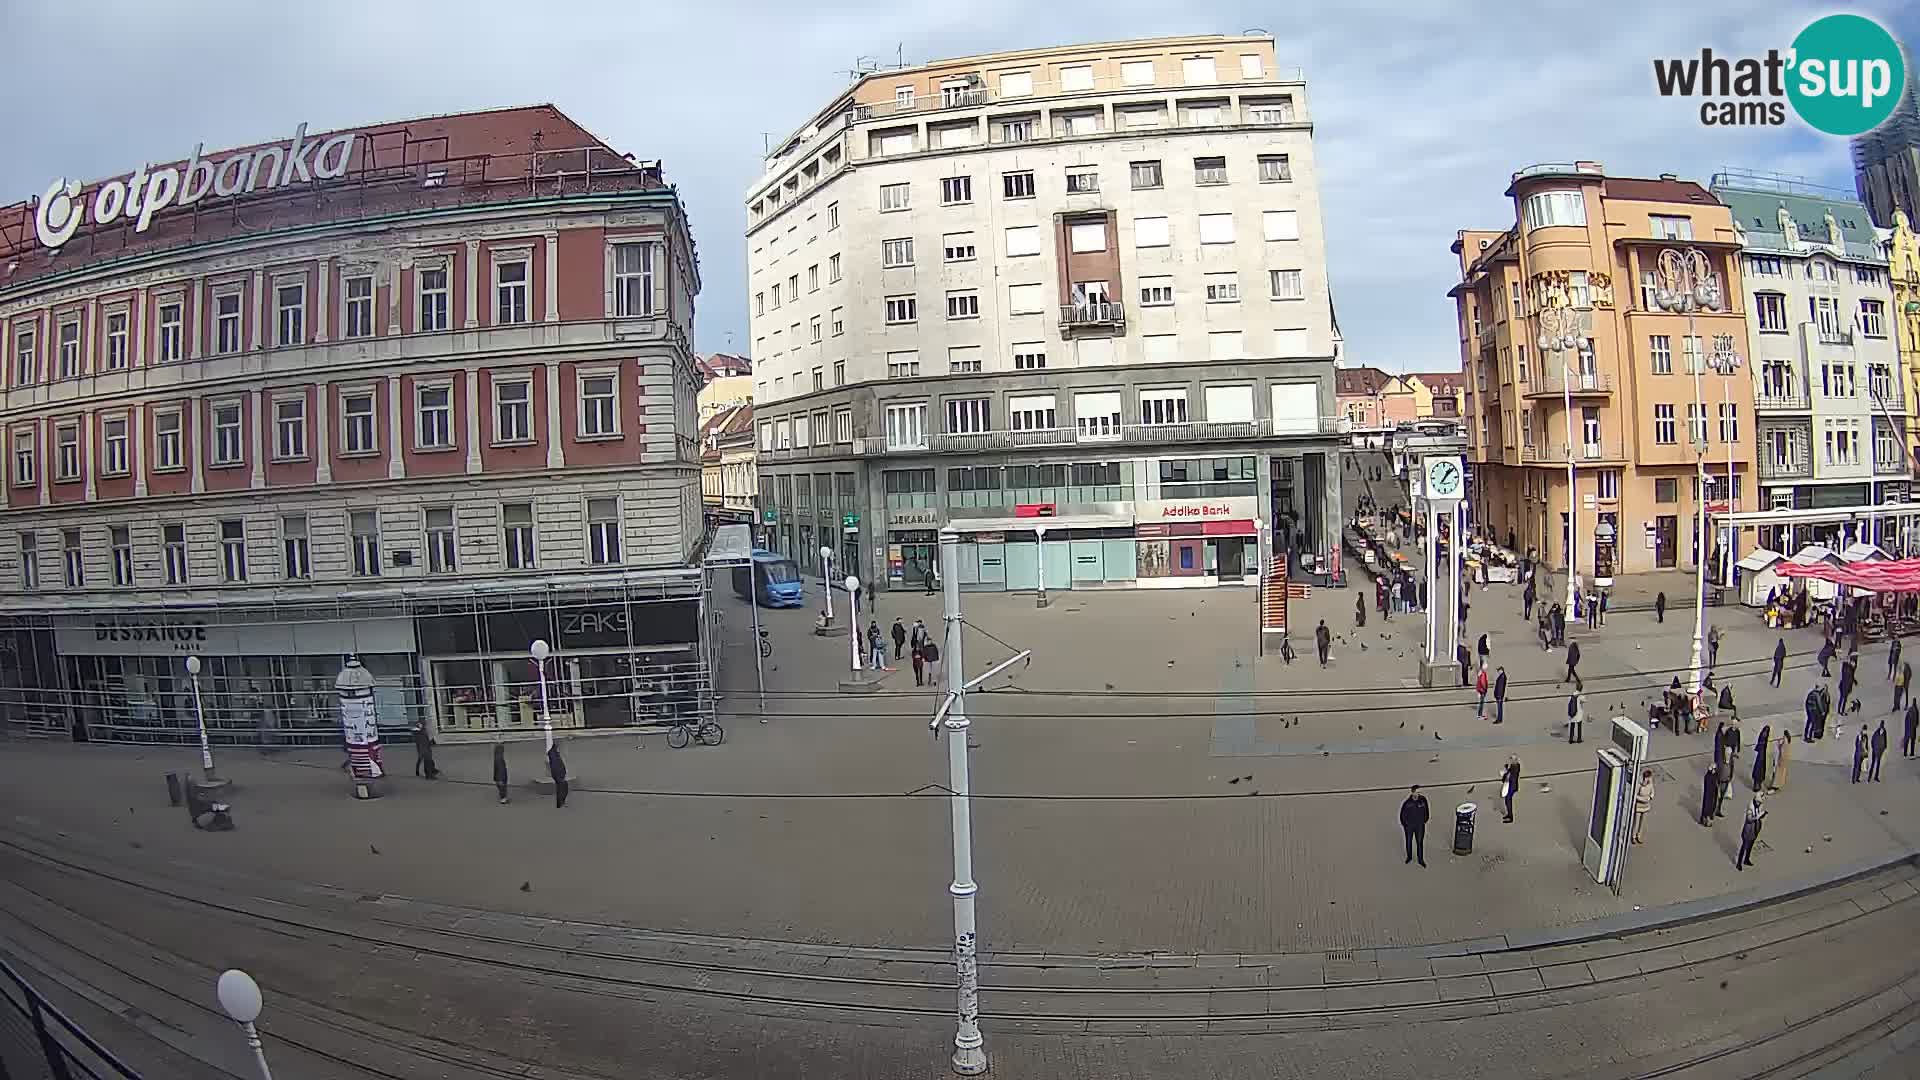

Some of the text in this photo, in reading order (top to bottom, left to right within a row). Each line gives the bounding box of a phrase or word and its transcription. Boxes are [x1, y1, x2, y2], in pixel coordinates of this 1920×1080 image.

[1162, 503, 1231, 517] Addiko Bank
[95, 622, 207, 641] DESSANGE
